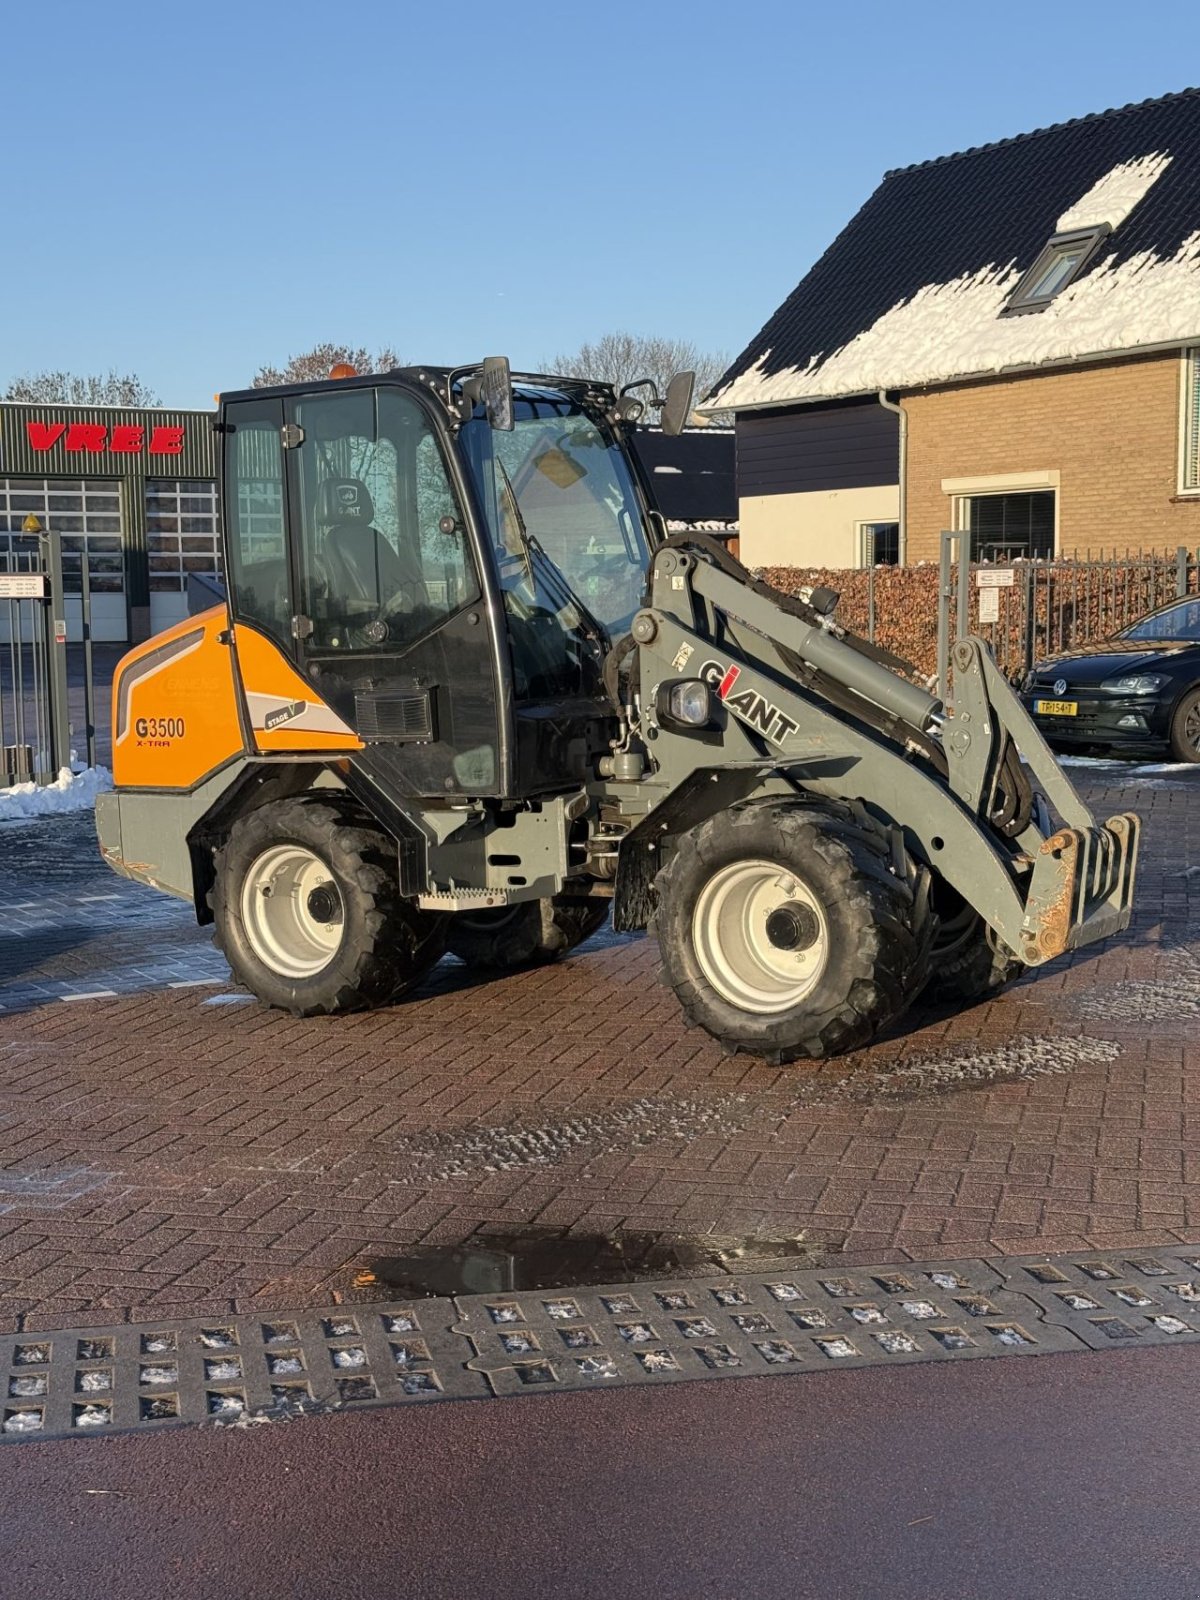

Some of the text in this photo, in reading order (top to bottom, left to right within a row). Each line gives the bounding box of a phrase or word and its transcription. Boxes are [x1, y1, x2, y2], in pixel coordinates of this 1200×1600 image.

[26, 422, 185, 454] VREE
[698, 660, 800, 745] GIANT
[135, 717, 185, 738] G3500
[267, 712, 289, 728] STAGE
